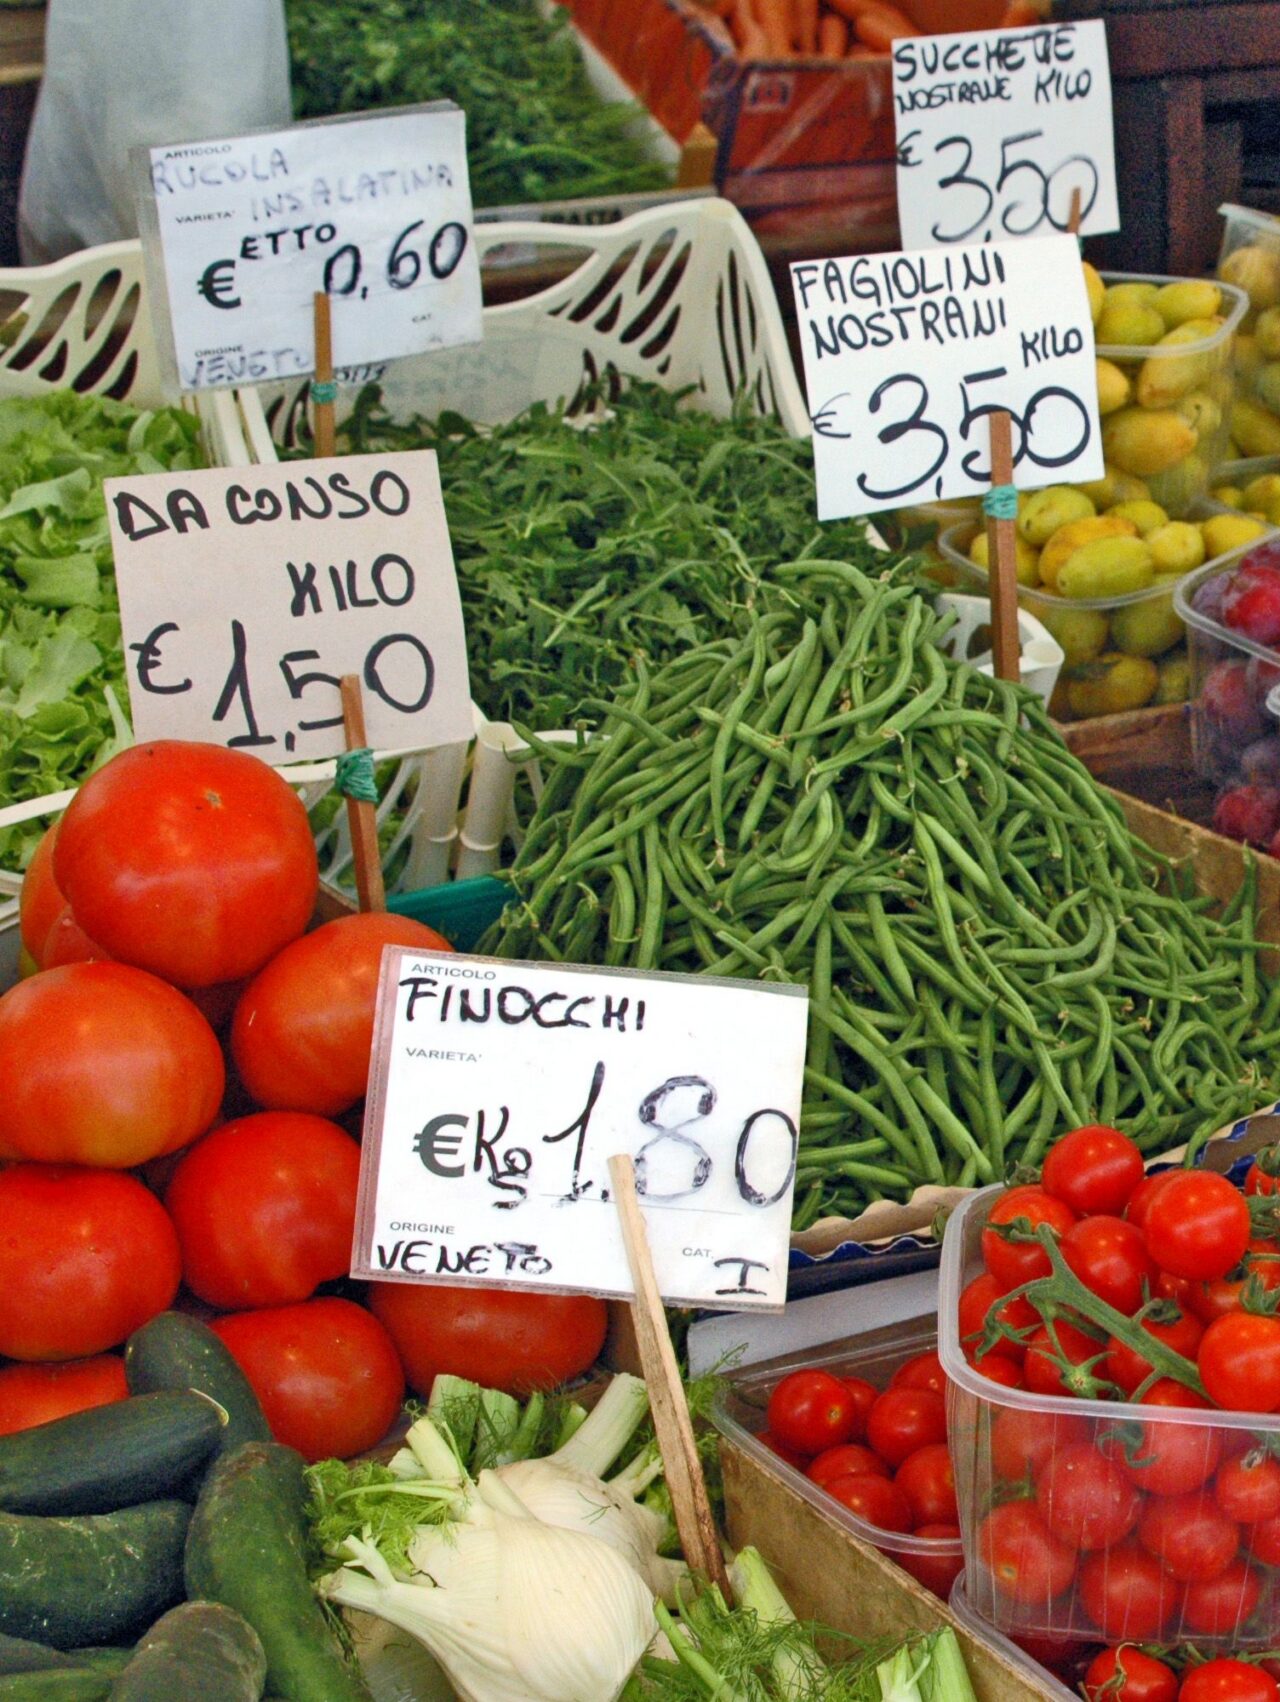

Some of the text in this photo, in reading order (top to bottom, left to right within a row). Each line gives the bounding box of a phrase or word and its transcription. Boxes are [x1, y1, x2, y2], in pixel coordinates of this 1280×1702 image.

[1035, 67, 1092, 104] KILO
[152, 148, 289, 196] RUCOLA
[164, 144, 232, 159] ARTICOLO
[196, 220, 467, 309] € 0,60
[240, 222, 337, 260] ETTO
[793, 248, 1006, 309] FAGIOLINI
[810, 296, 1083, 368] NOSTRANI KILO
[856, 366, 1091, 500] 3,50
[113, 489, 210, 542] DA
[286, 553, 415, 618] KILO
[129, 622, 193, 695] €
[411, 963, 497, 981] ARTICOLO
[399, 977, 646, 1032] FINOCCHI
[389, 1221, 455, 1235] ORIGINE
[376, 1240, 553, 1276] VENETO
